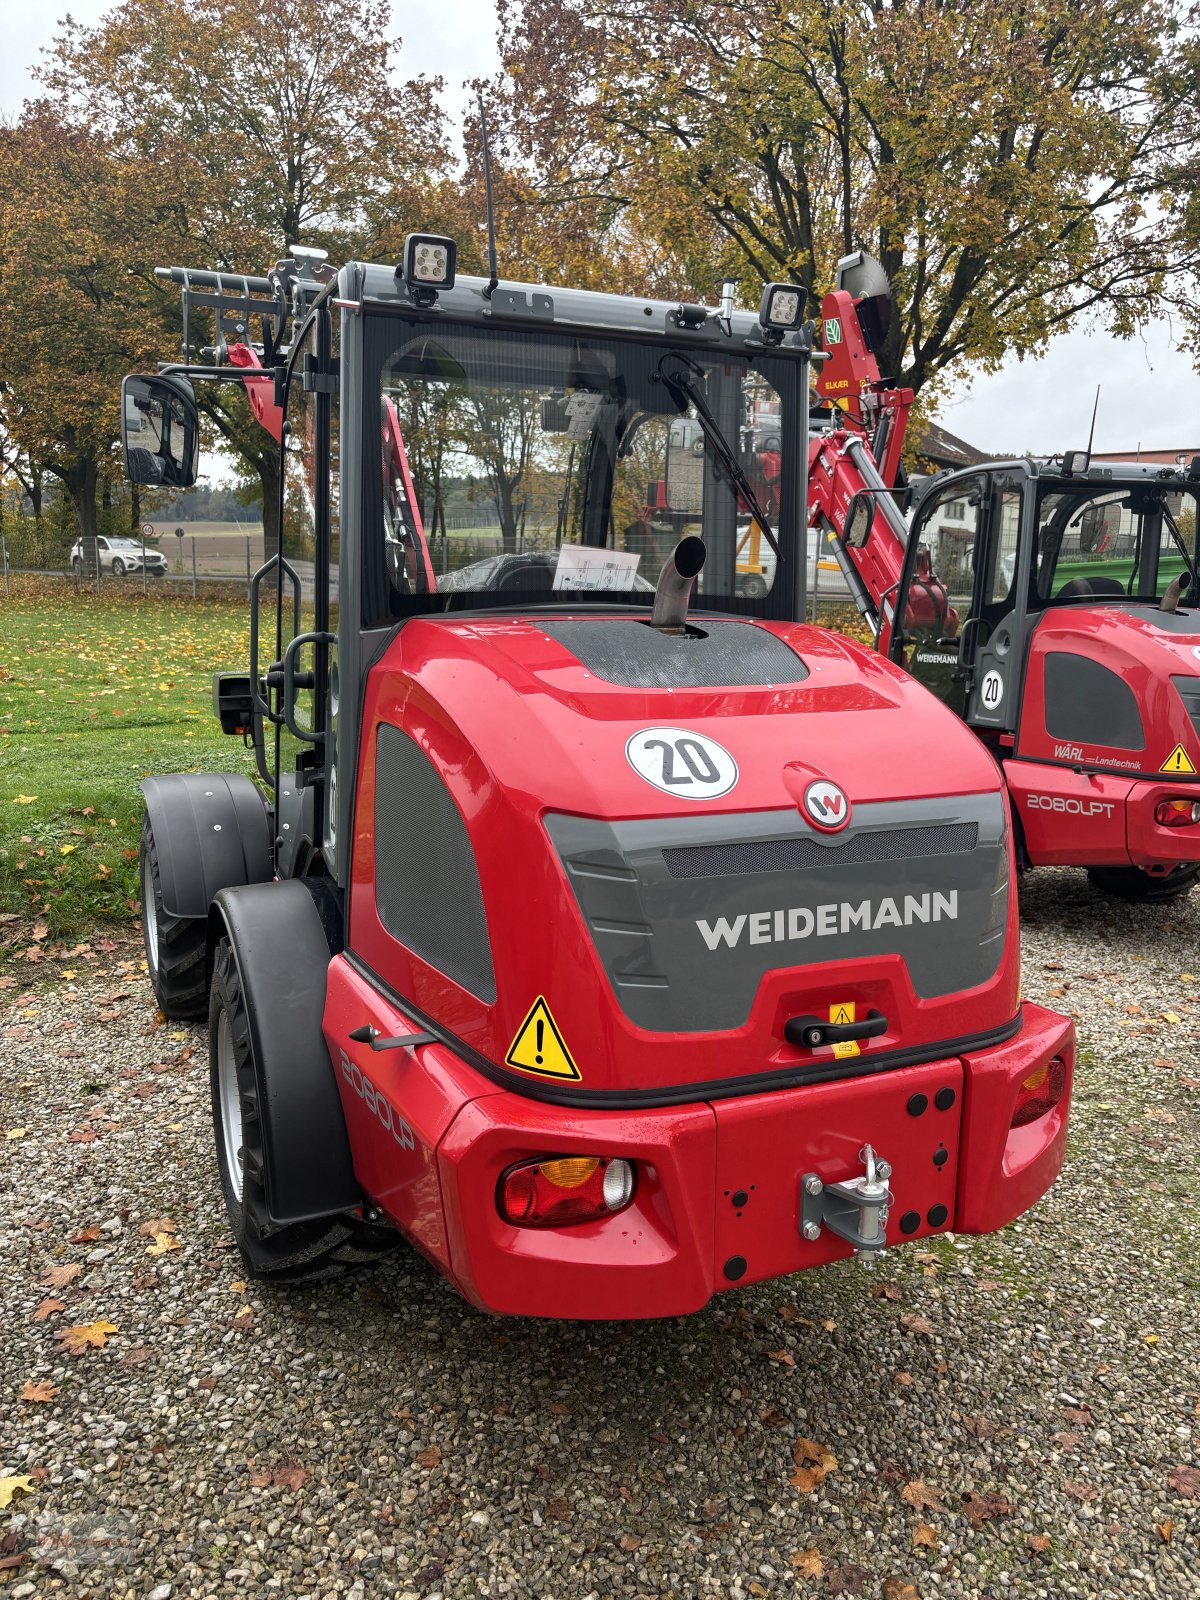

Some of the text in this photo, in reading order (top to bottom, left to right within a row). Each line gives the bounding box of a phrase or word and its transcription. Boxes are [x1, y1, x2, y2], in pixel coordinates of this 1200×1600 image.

[825, 380, 849, 390] ELKÆR
[916, 653, 958, 664] WEIDEMANN
[985, 677, 999, 703] 20
[644, 738, 721, 785] 20
[1054, 744, 1142, 770] WÄRL Landtechnik
[1027, 794, 1115, 819] 2080LPT
[695, 889, 958, 950] WEIDEMANN
